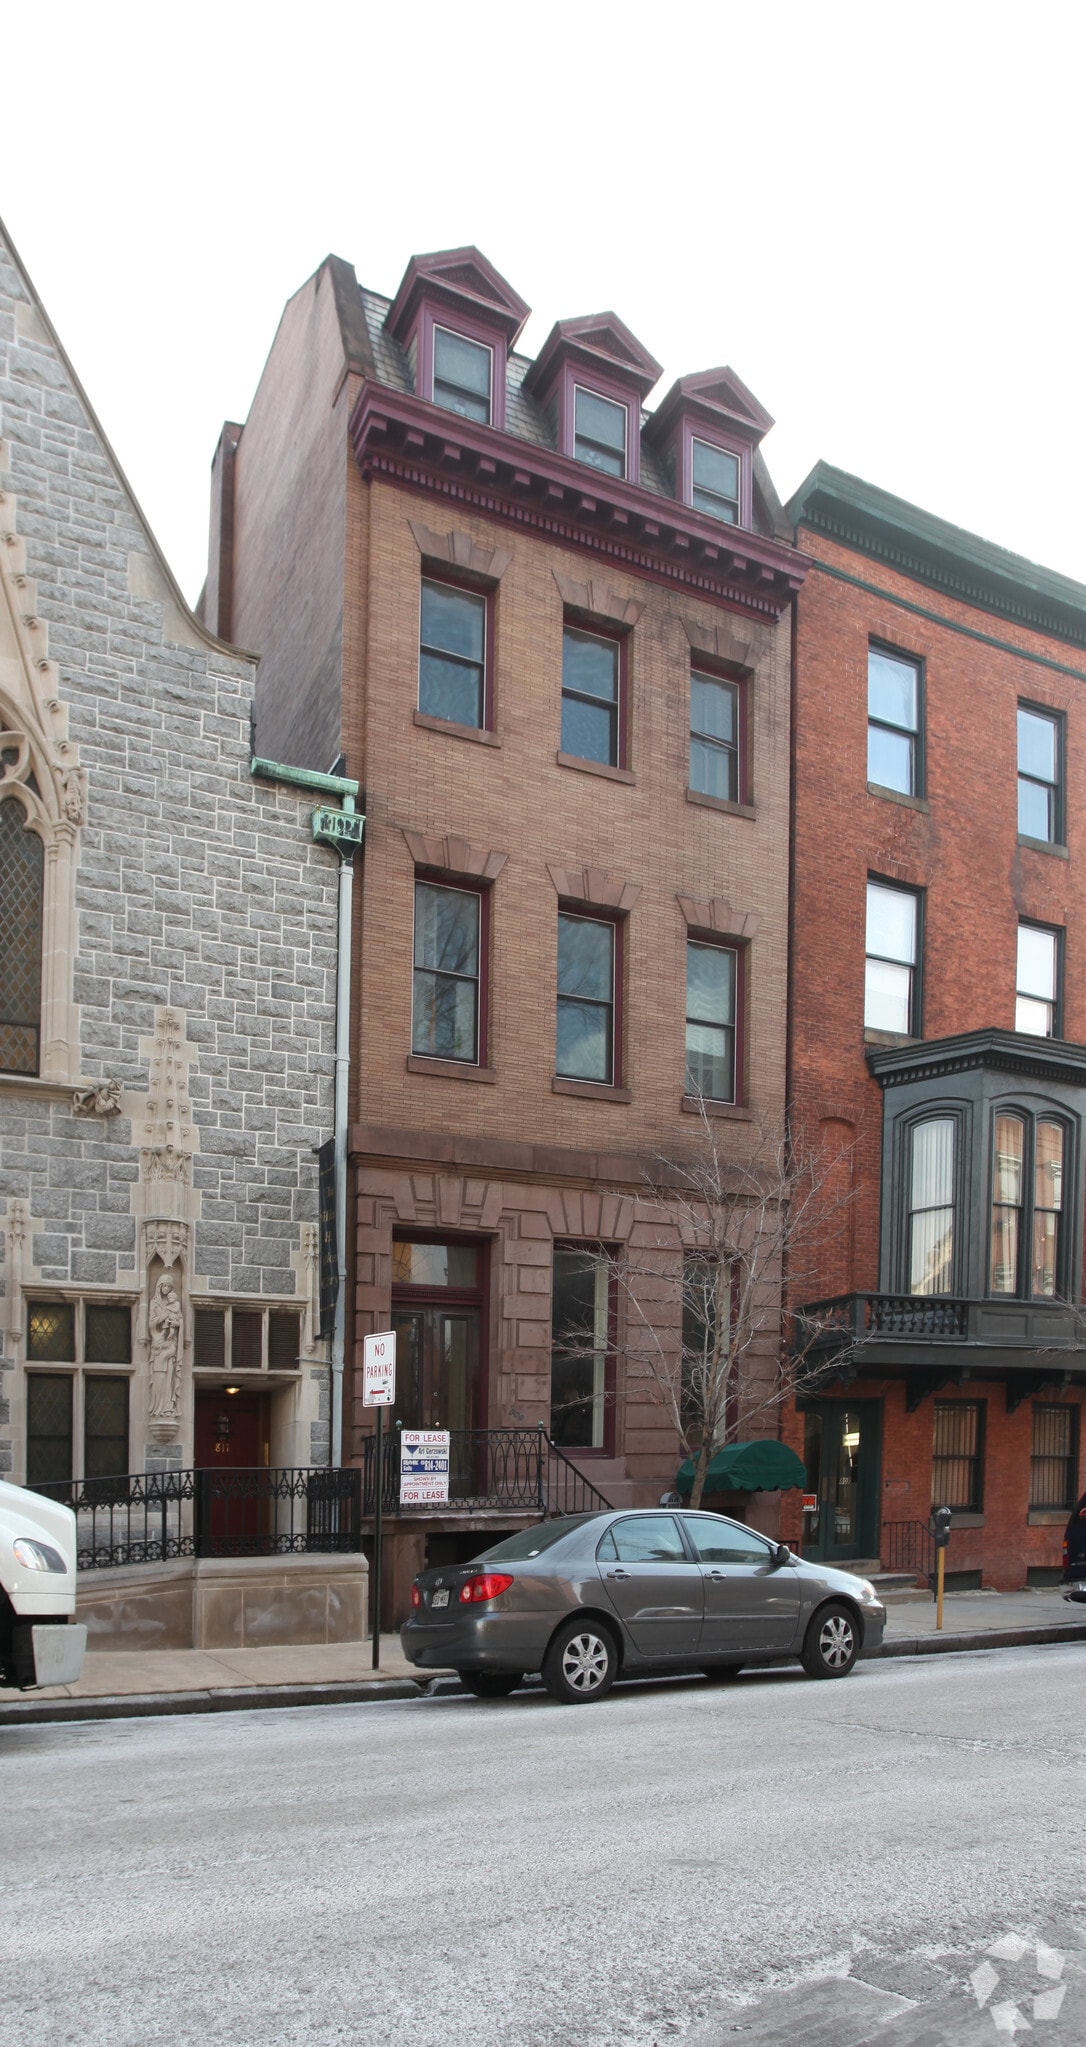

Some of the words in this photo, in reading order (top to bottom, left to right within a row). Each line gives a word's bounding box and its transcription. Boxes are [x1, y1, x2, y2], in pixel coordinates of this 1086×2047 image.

[374, 1343, 385, 1357] NO
[367, 1363, 392, 1379] PARKING
[215, 1442, 230, 1453] 811
[422, 1491, 445, 1499] LEASE
